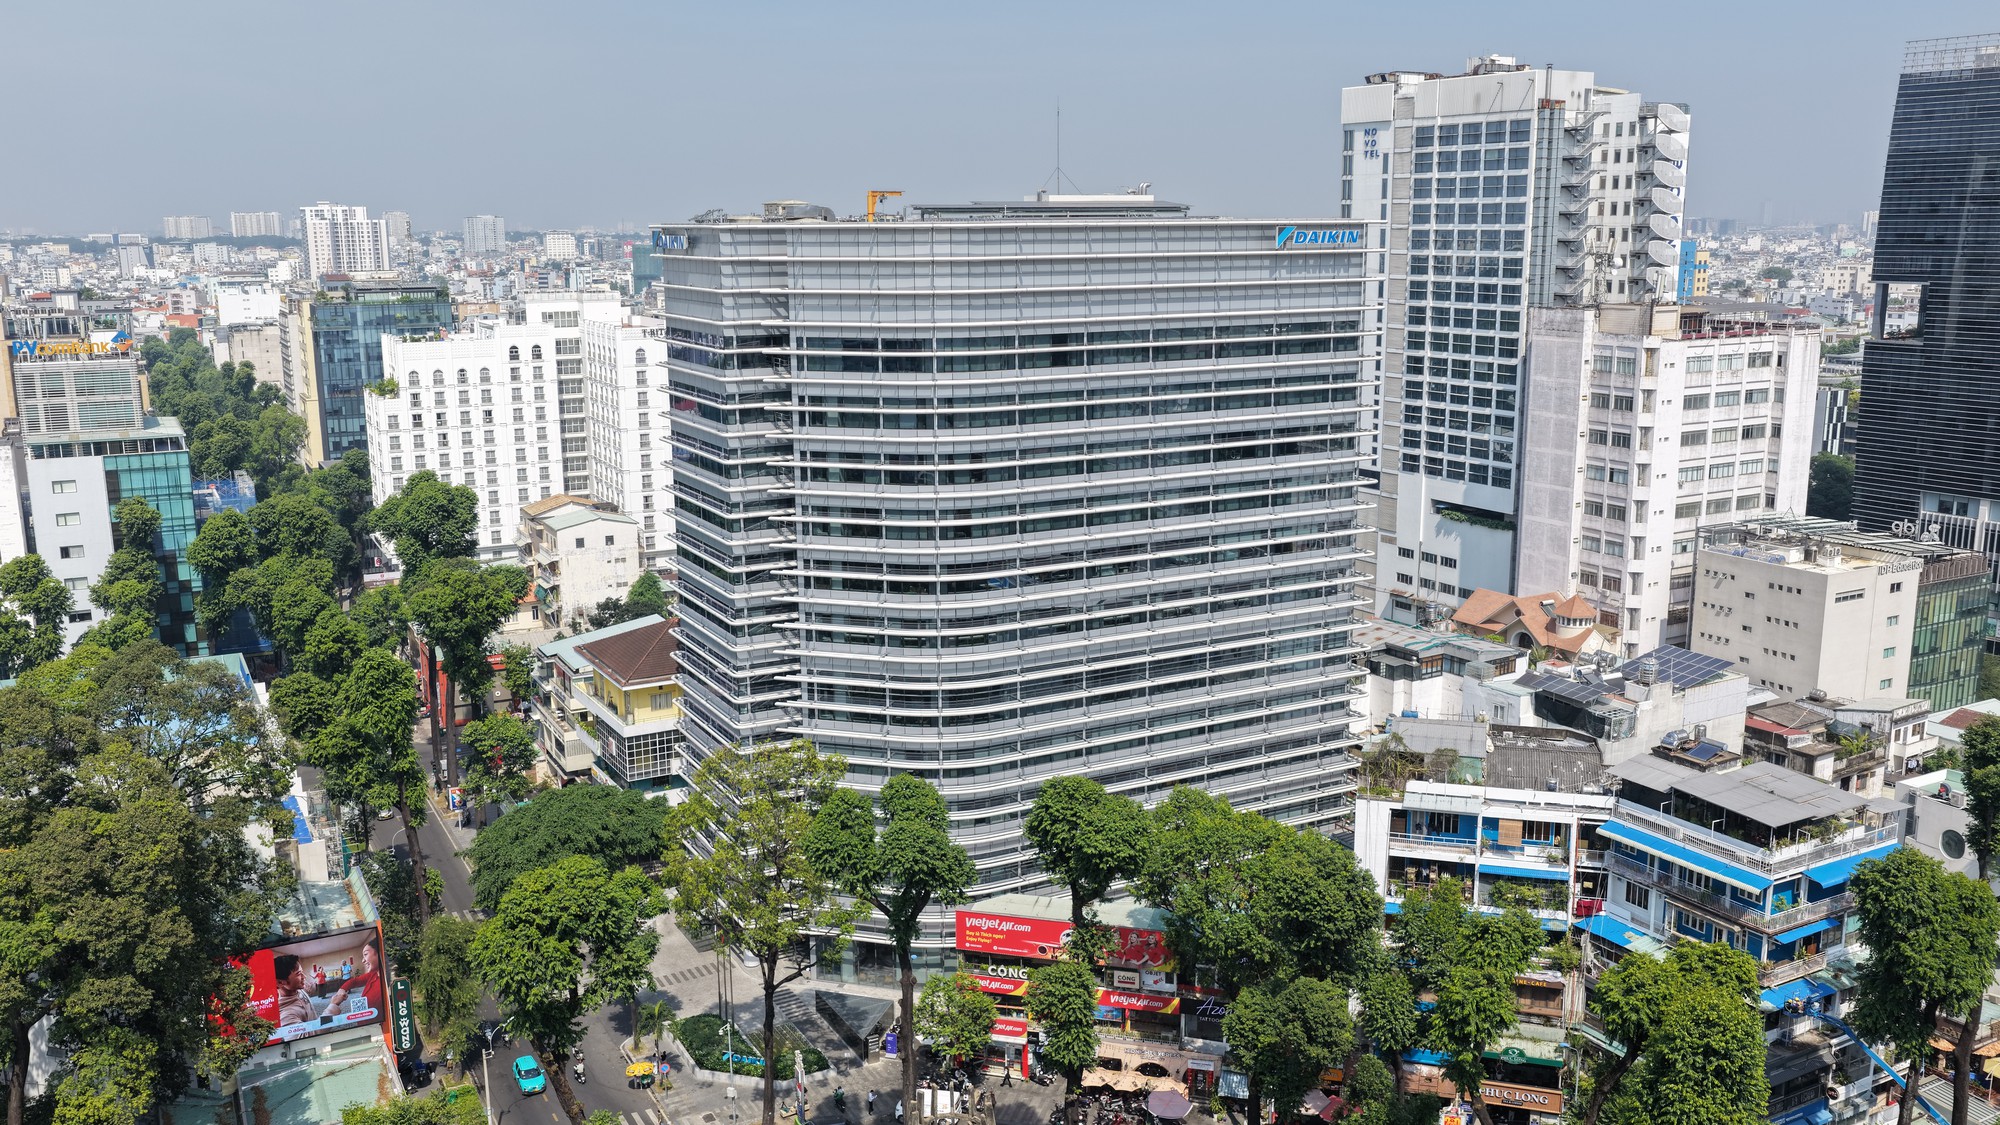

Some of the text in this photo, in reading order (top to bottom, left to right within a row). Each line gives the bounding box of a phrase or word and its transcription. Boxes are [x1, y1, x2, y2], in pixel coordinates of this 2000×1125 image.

[1364, 128, 1377, 136] NO
[1364, 139, 1376, 147] VO
[1364, 150, 1379, 158] TEL
[658, 235, 685, 249] DAIKIN
[1293, 230, 1360, 244] DAIKIN
[12, 340, 111, 356] PVcomBank
[1514, 1092, 1548, 1104] LONG
